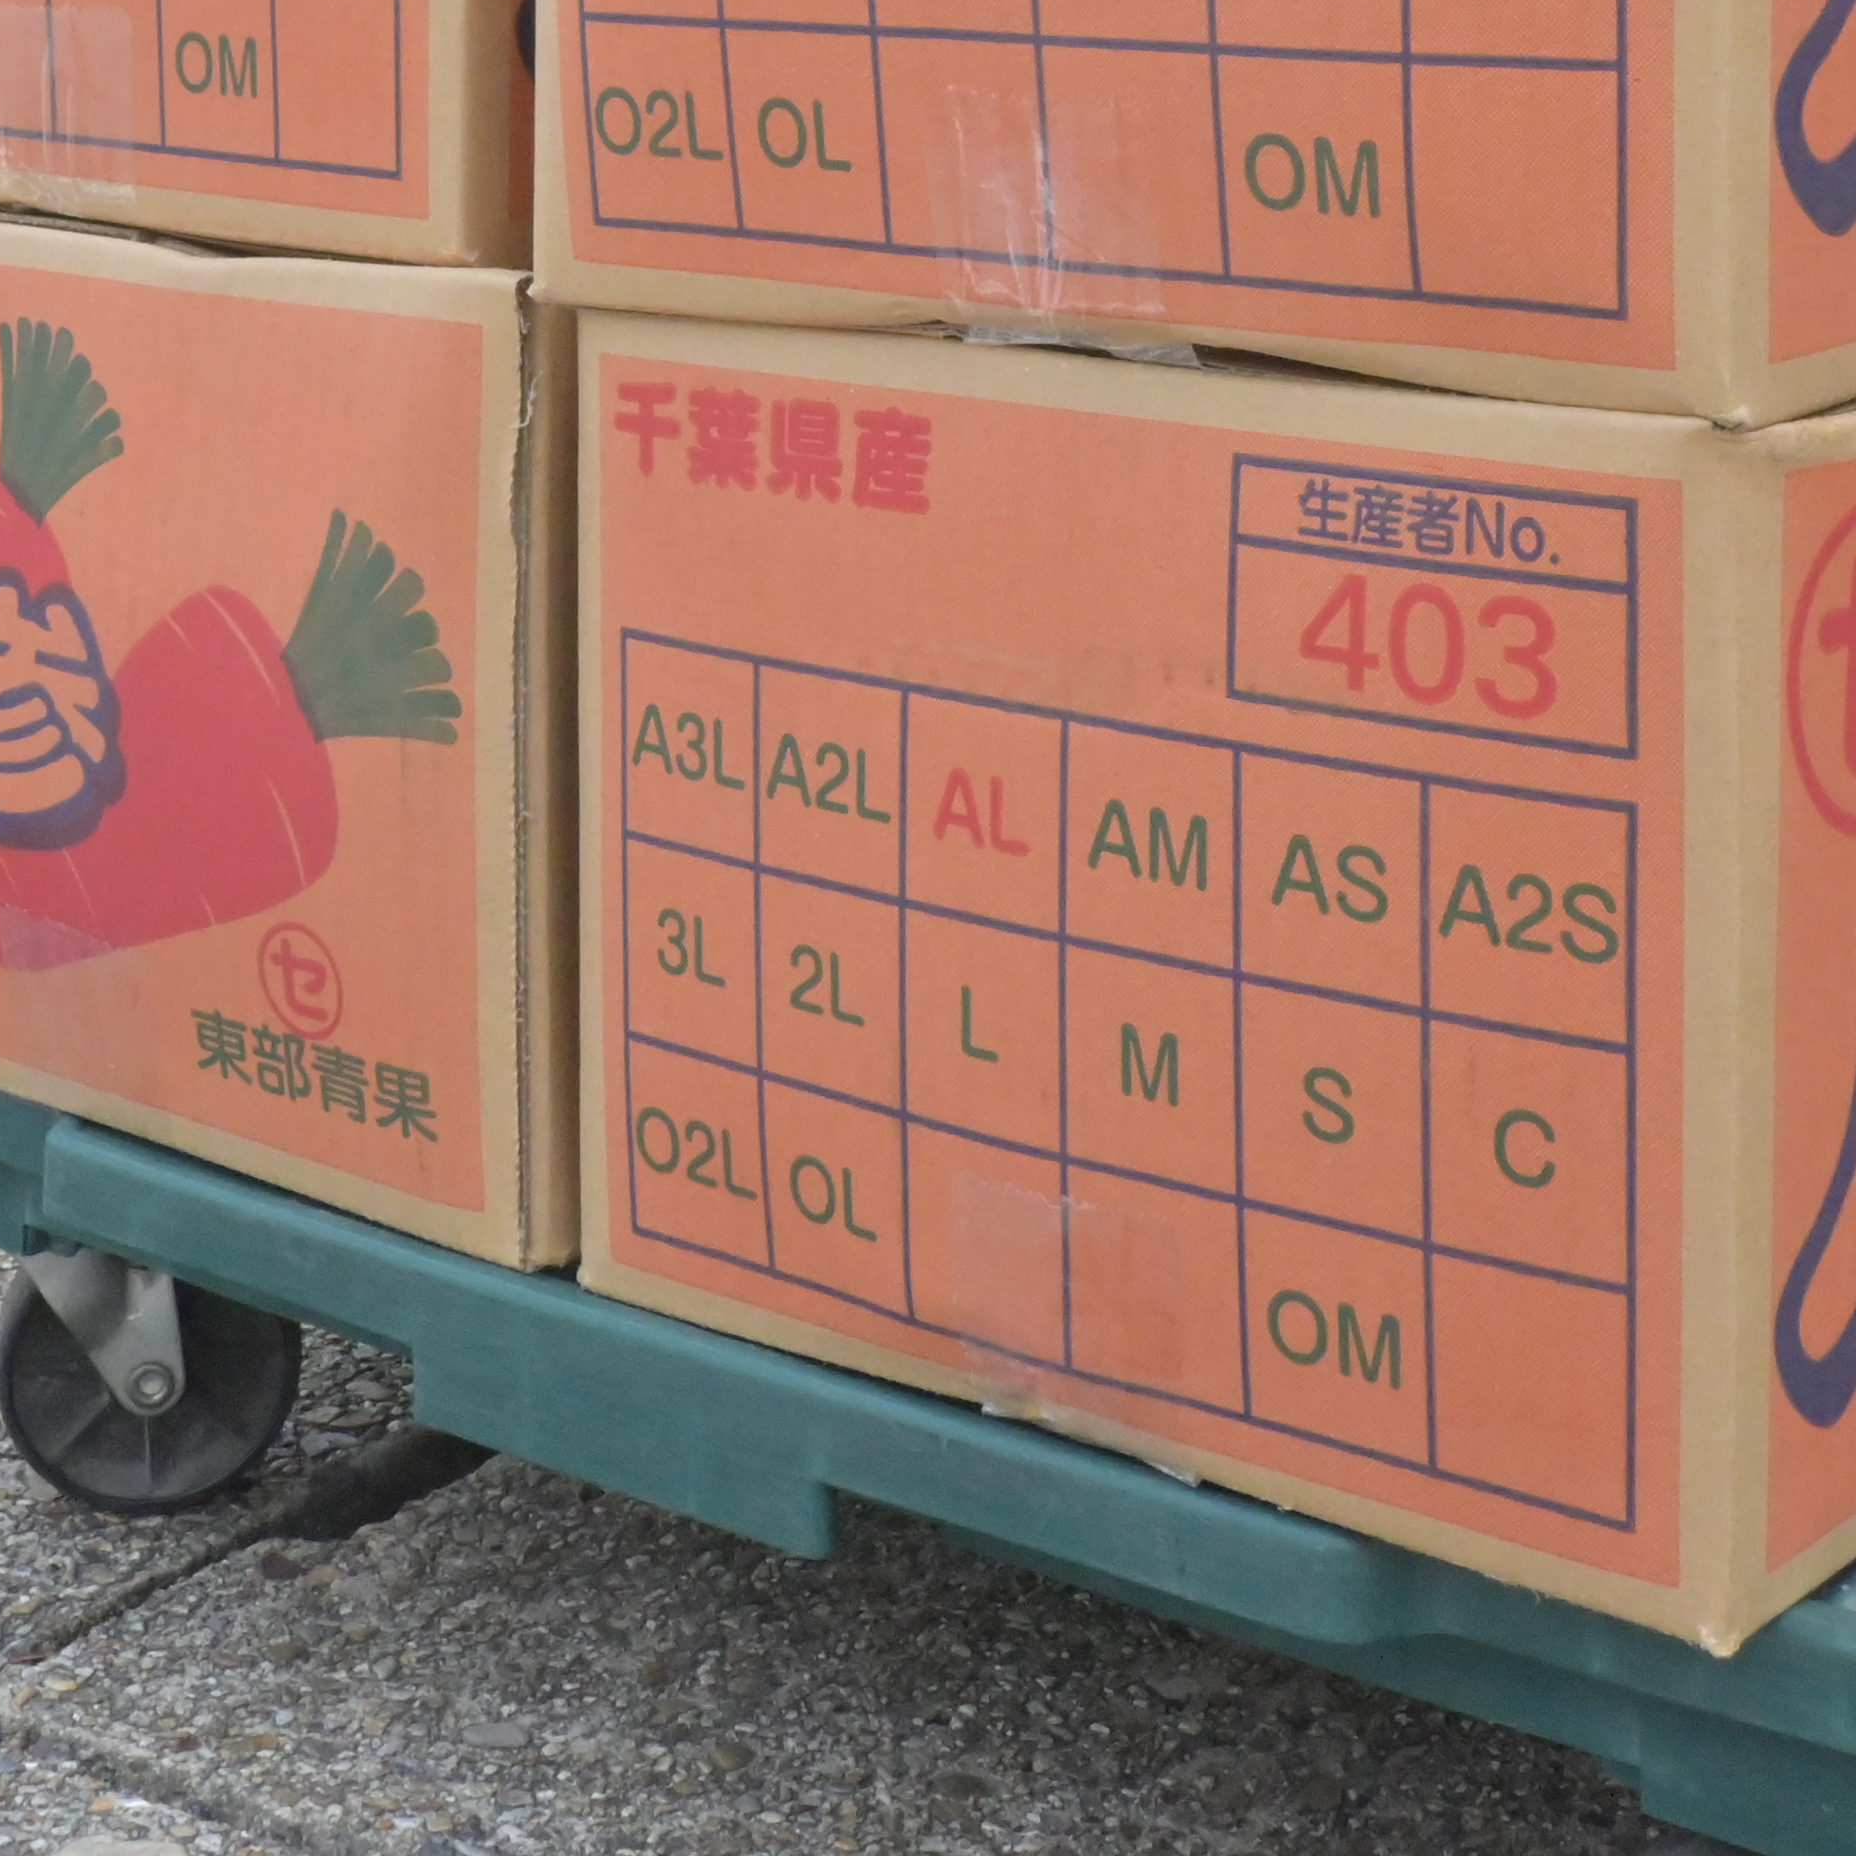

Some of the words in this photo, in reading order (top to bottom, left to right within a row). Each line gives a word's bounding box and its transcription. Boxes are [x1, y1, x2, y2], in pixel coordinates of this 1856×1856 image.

[174, 31, 259, 99] OM
[756, 95, 852, 173] OL
[1243, 131, 1382, 219] OM
[612, 380, 934, 516] 千葉県産
[1297, 478, 1561, 566] 生産者No.
[1299, 572, 1559, 722] 403
[630, 701, 747, 793] A3L
[765, 732, 893, 826] A2L
[932, 766, 1031, 860] AL
[1087, 798, 1210, 893] AM
[1271, 833, 1390, 924] AS
[1438, 863, 1620, 965] A2S
[190, 1008, 439, 1142] 東部青果
[656, 908, 726, 990] 3L
[789, 944, 866, 1028] 2L
[959, 986, 999, 1064] L
[1119, 1024, 1180, 1108] M
[1301, 1065, 1356, 1144] S
[1493, 1108, 1558, 1190] C
[789, 1155, 878, 1243] OL
[1266, 1288, 1403, 1391] OM
